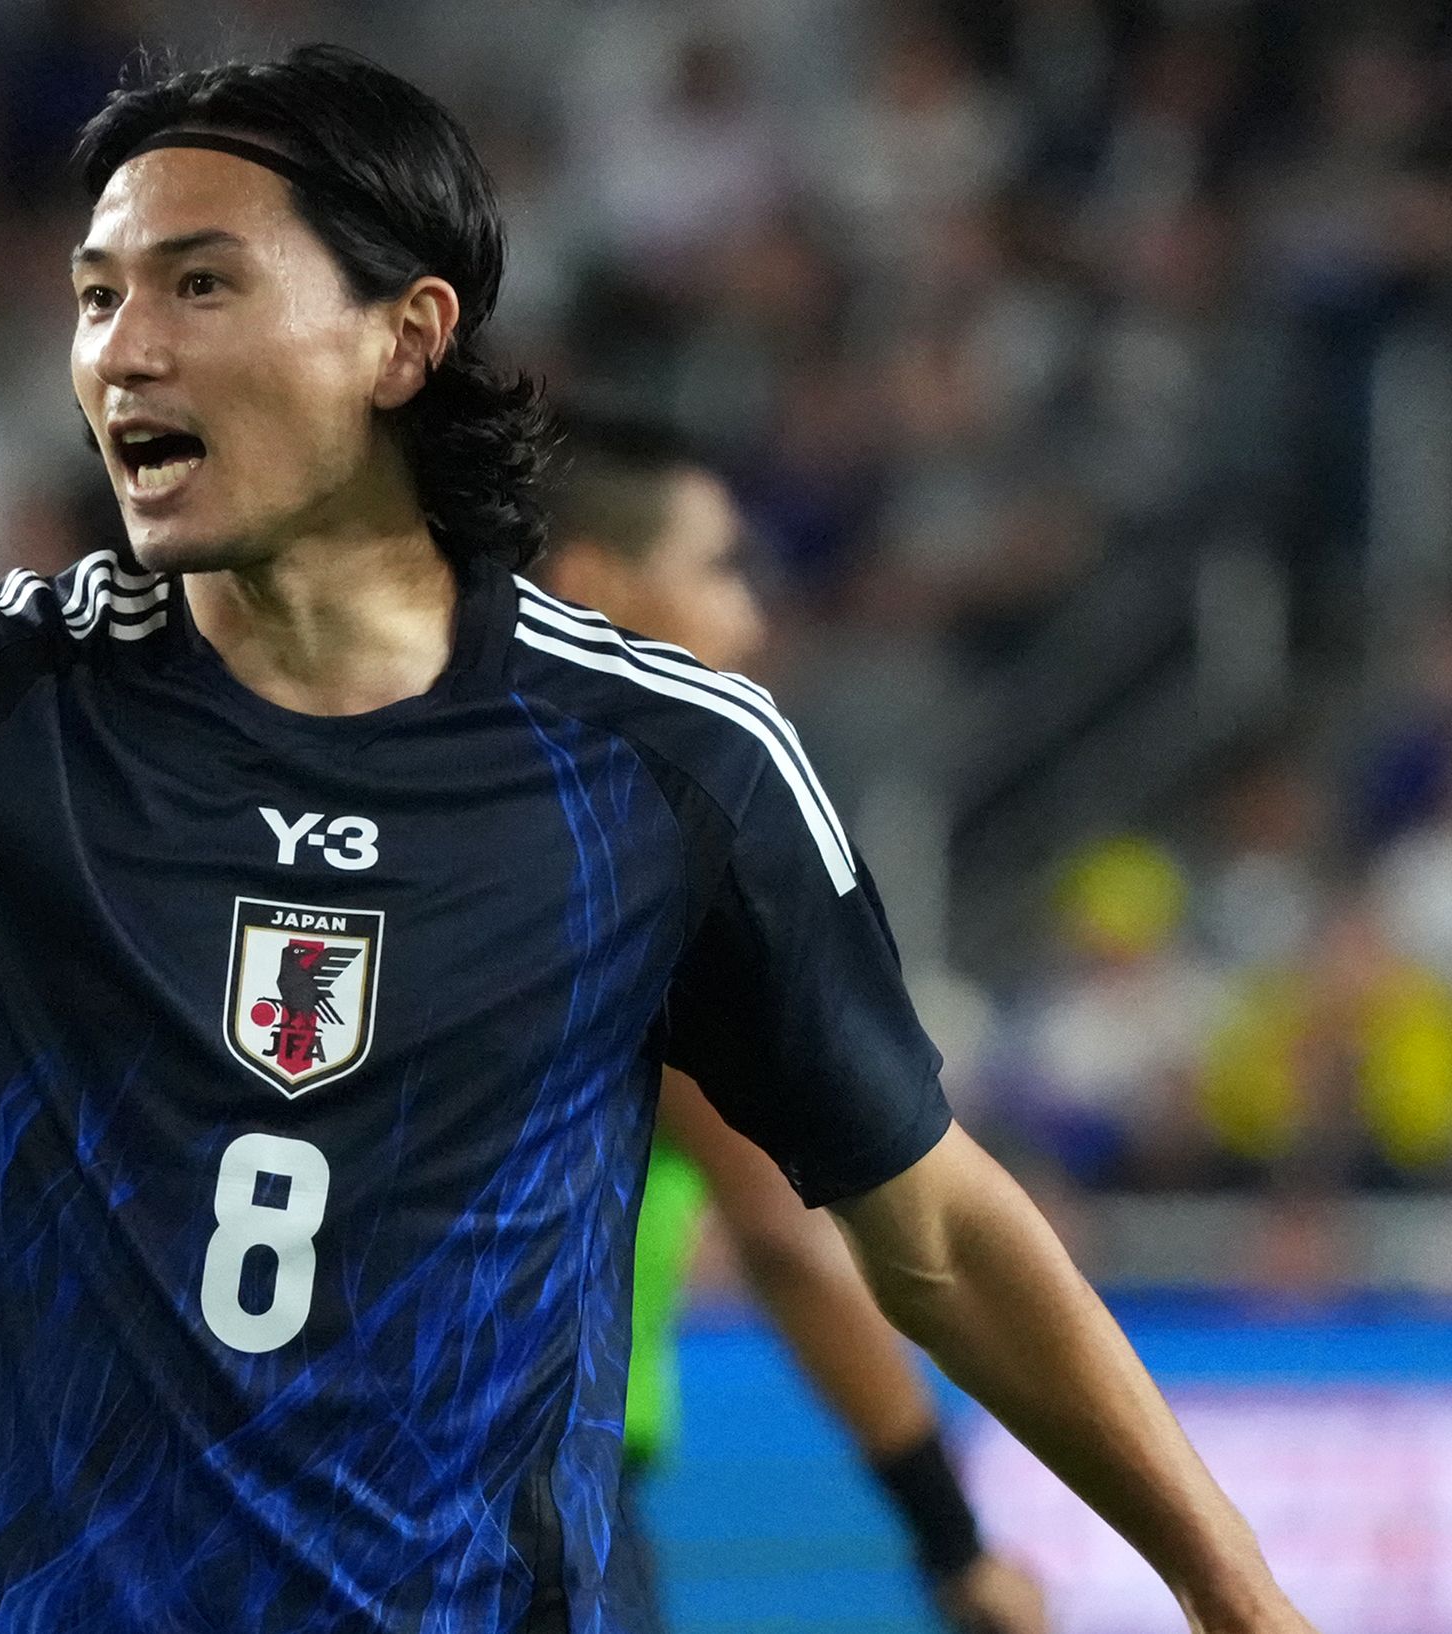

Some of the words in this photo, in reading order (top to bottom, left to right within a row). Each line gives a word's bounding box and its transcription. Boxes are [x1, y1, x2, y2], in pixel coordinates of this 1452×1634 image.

[258, 807, 379, 870] Y-3
[271, 911, 347, 932] JAPAN
[261, 1031, 327, 1063] JFA
[201, 1133, 330, 1353] 8
